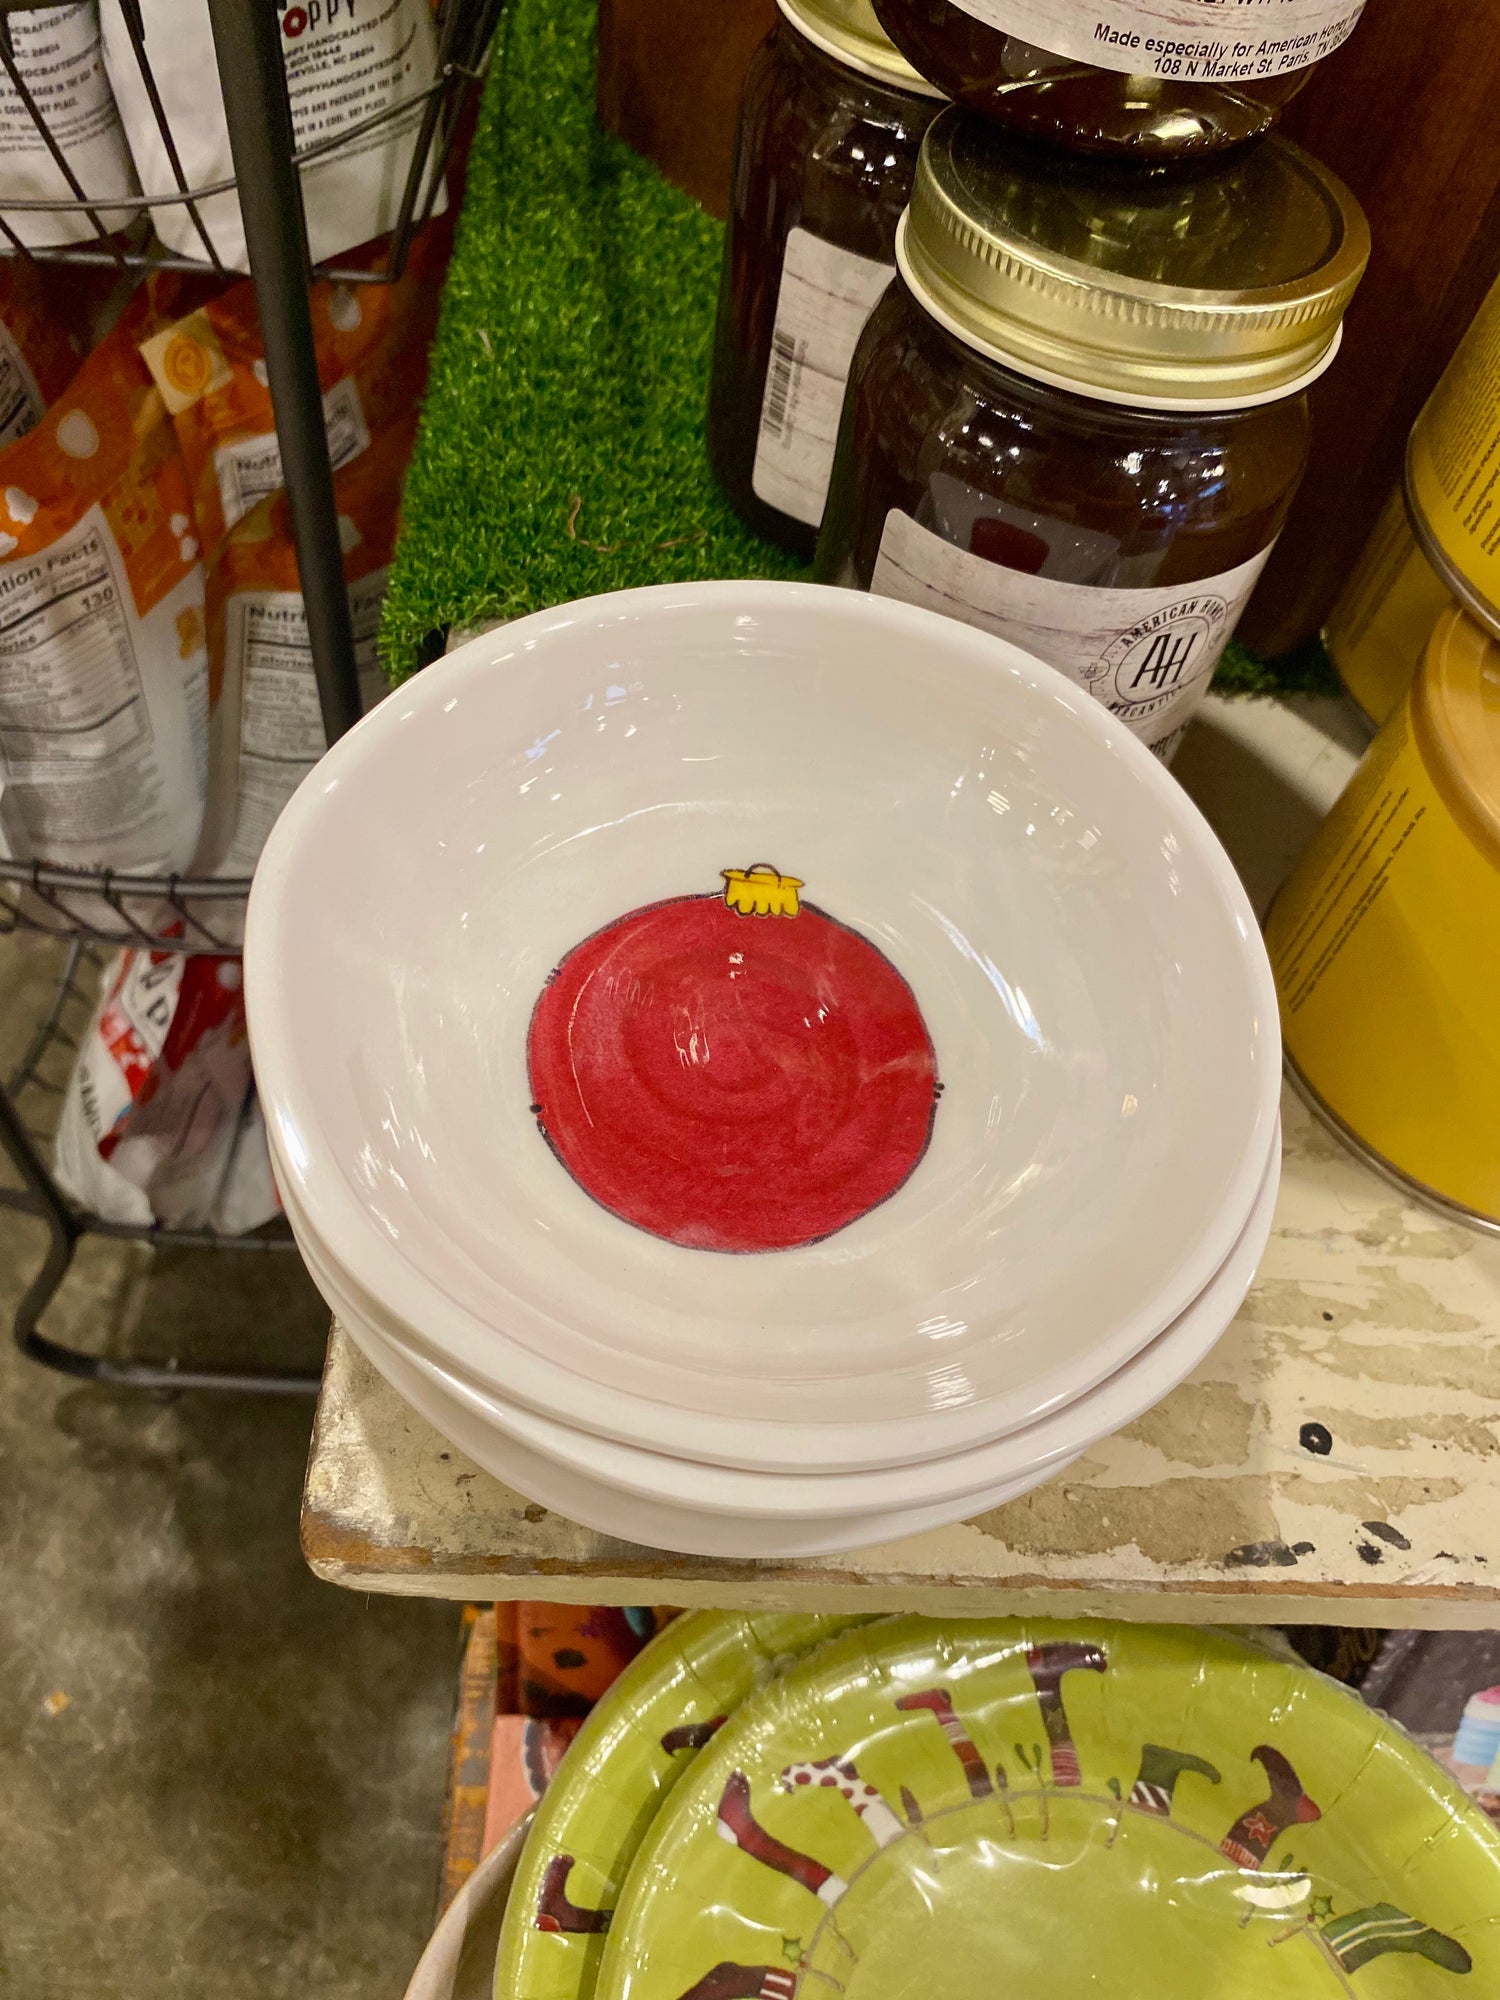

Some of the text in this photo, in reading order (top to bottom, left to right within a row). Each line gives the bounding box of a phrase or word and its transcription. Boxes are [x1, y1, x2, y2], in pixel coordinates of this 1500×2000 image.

[1094, 23, 1140, 48] Made
[1145, 38, 1228, 61] especially
[1231, 42, 1254, 57] for
[1255, 32, 1318, 56] American
[1154, 58, 1181, 75] 108
[1185, 60, 1199, 77] N
[1201, 61, 1254, 77] Market
[1315, 39, 1331, 57] TN
[1121, 600, 1198, 648] AMERICAN
[1130, 631, 1199, 690] AH
